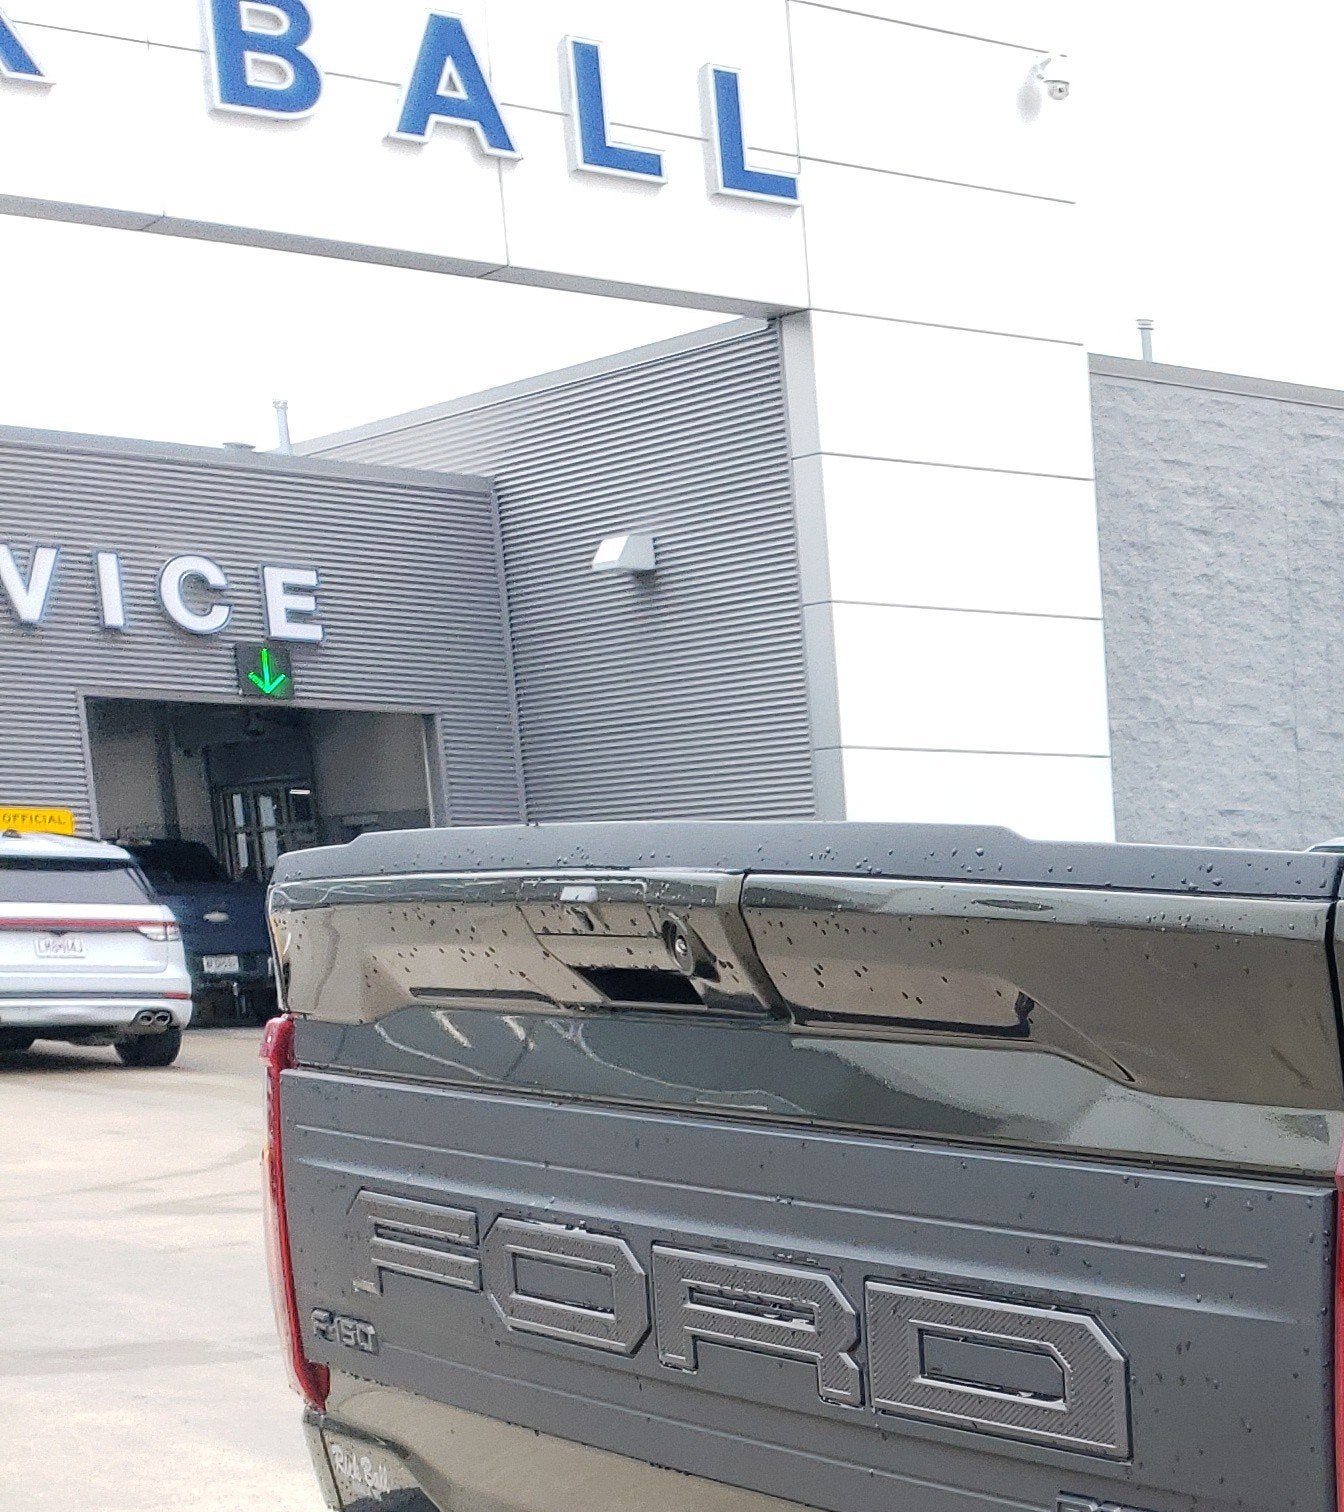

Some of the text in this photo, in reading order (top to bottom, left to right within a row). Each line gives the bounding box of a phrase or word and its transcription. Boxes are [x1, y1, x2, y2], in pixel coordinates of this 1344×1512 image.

[203, 0, 801, 206] BALL
[0, 545, 325, 642] VICE
[2, 813, 66, 825] OFFICIAL
[346, 1187, 1133, 1462] FORD
